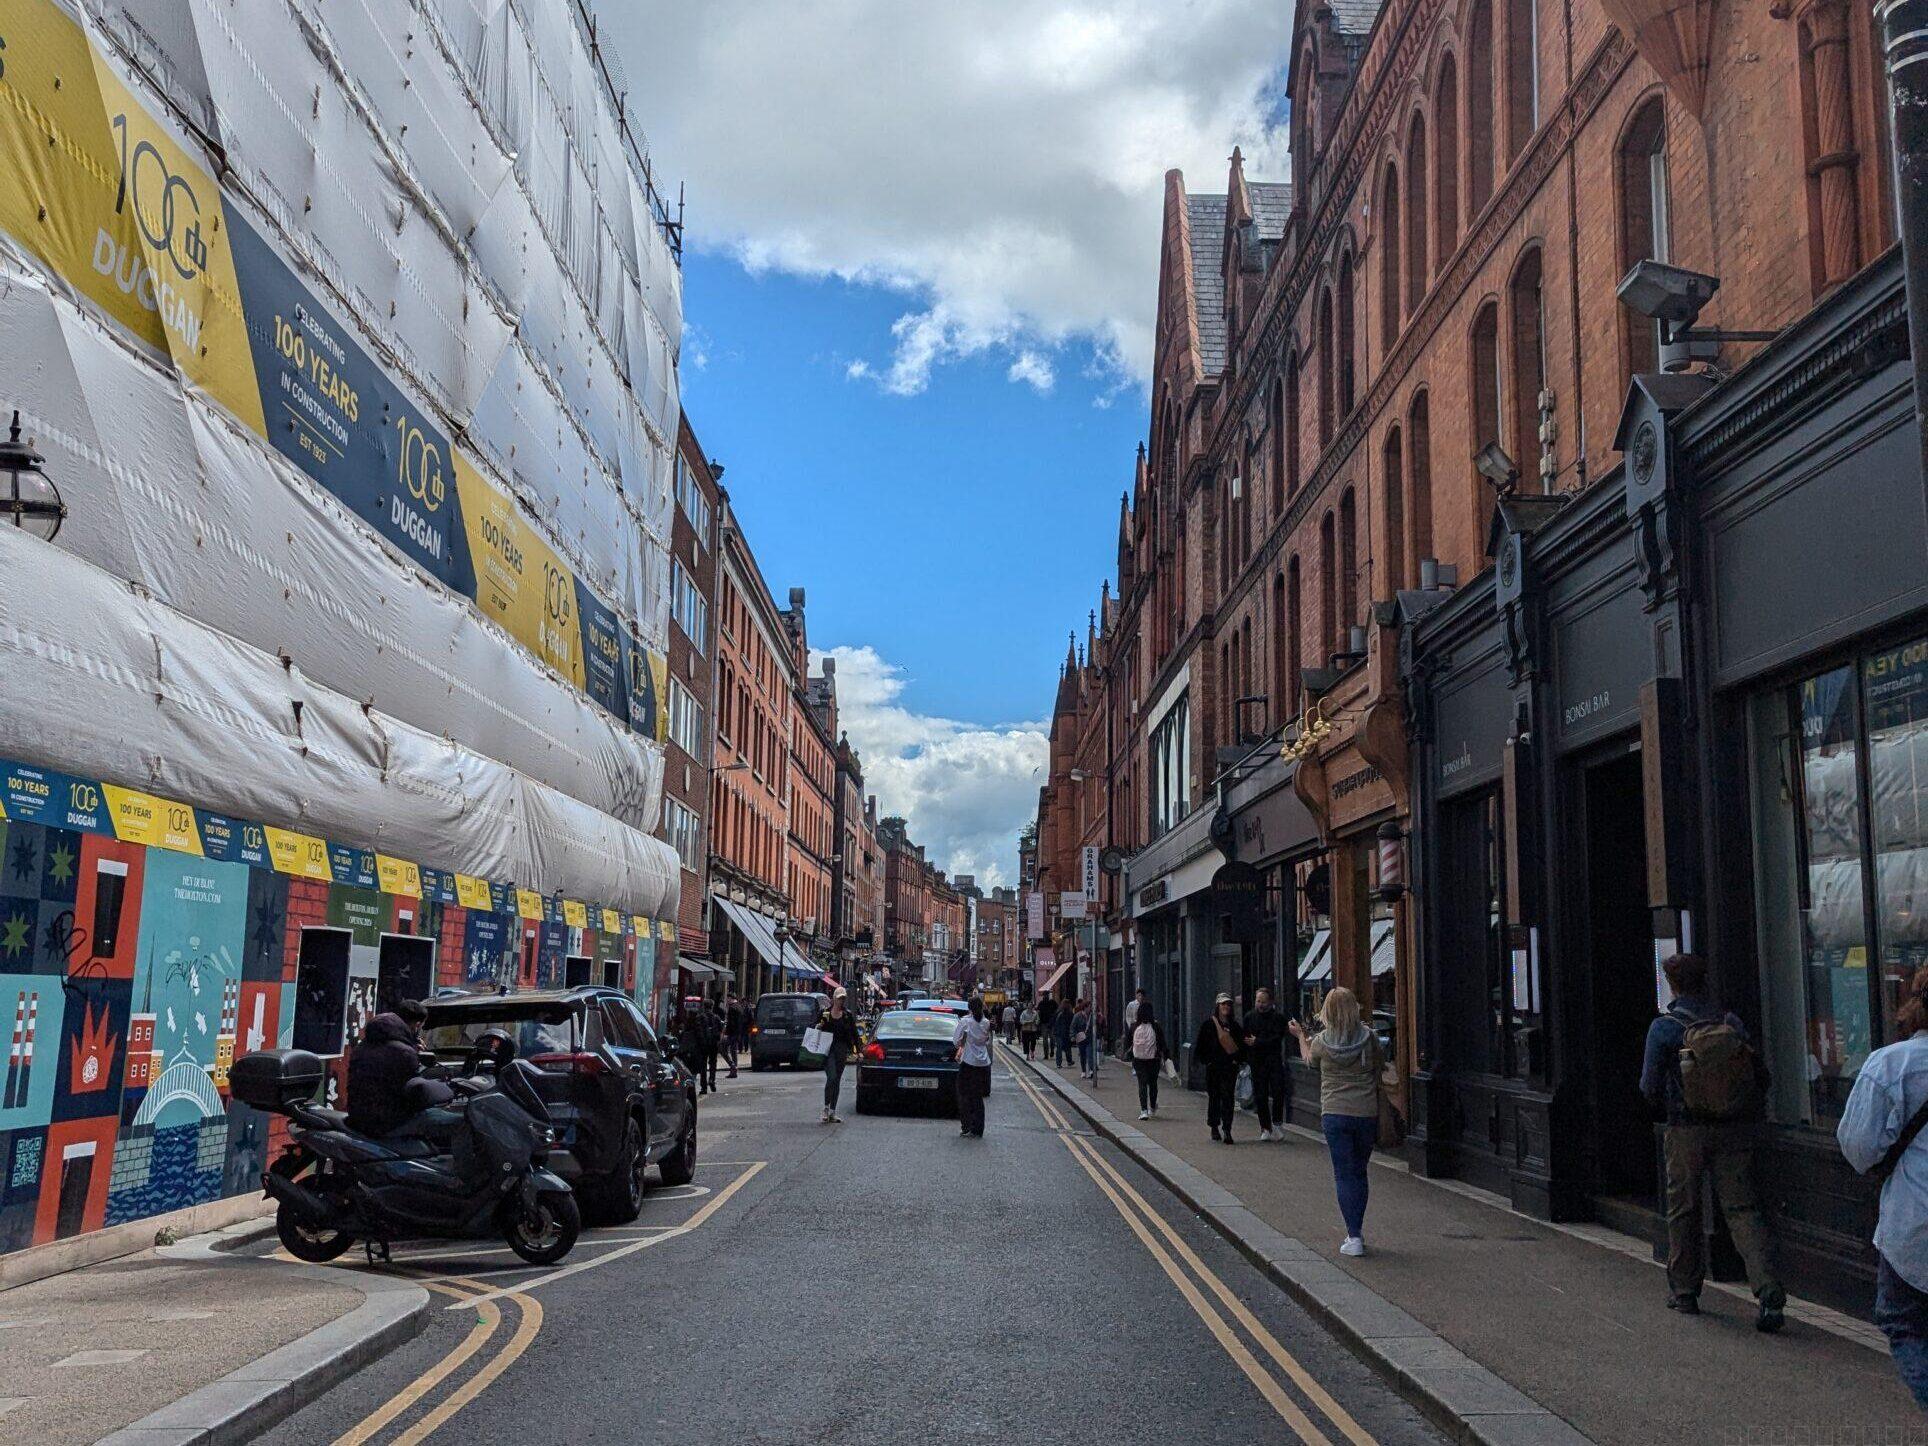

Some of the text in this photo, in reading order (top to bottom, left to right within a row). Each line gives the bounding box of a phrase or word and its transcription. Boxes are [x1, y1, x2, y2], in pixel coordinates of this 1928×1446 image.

[92, 227, 200, 356] DUGGAN
[295, 302, 345, 365] CELEBRATING
[275, 314, 358, 423] 100 YEARS
[281, 371, 348, 446] IN CONSTRUCTION
[299, 432, 312, 451] EST
[391, 494, 441, 559] DUGGAN
[480, 515, 499, 549] 100
[500, 531, 523, 576] YEARS
[1565, 691, 1610, 725] BONSAI BAR
[8, 777, 50, 796] 100 YEARS
[67, 812, 97, 828] DUGGAN
[120, 803, 152, 819] 100 YEARS
[165, 833, 189, 847] DUGGAN
[241, 849, 262, 862] DUGGAN
[1086, 848, 1094, 887] GRAHAMS
